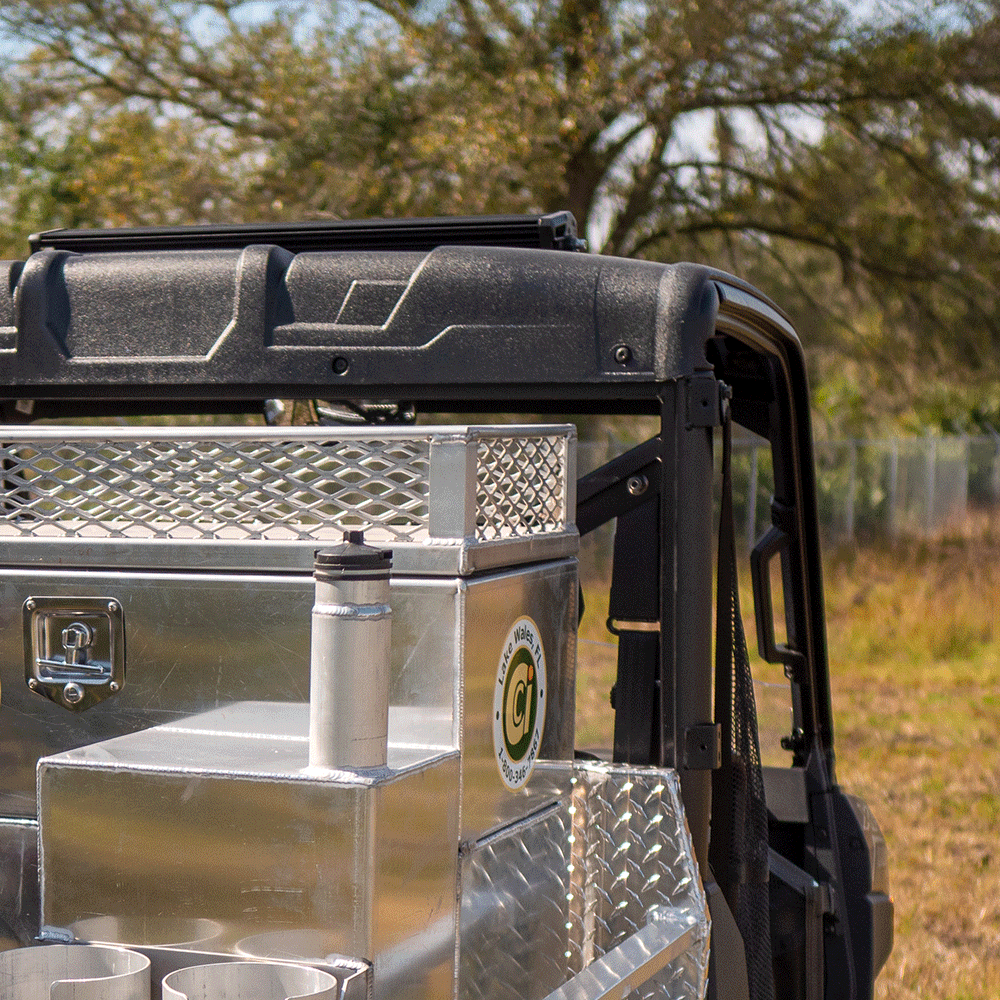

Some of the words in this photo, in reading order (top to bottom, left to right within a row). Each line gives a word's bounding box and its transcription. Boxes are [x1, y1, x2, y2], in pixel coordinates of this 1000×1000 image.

[498, 642, 513, 686] Lake
[514, 625, 535, 650] Wales,
[534, 645, 543, 669] FL
[498, 728, 540, 784] 1-800-346-7867
